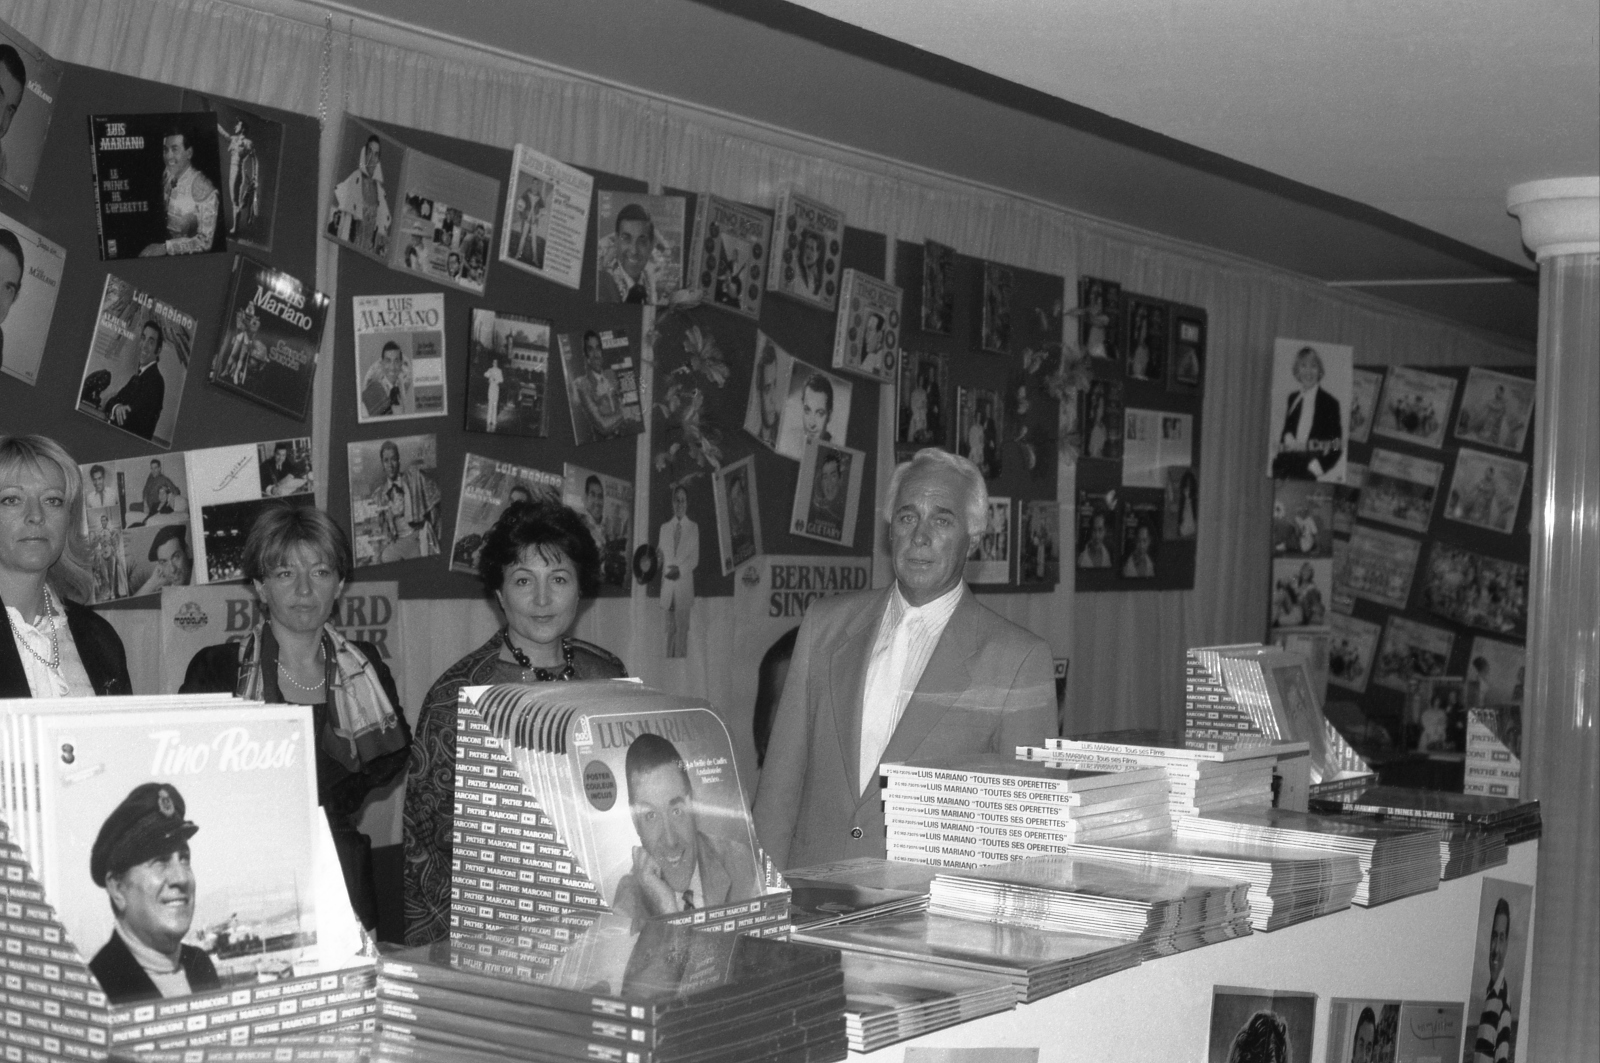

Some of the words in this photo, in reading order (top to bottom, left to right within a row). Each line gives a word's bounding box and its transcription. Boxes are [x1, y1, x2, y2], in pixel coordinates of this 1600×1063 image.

[105, 123, 126, 136] LUIS
[100, 136, 144, 150] MARIANO
[253, 284, 312, 330] Mariano
[386, 298, 412, 311] LUIS
[361, 308, 439, 328] MARIANO
[770, 565, 867, 590] BERNARD
[597, 721, 636, 749] LUIS
[149, 730, 209, 776] Tino
[212, 727, 300, 772] Rossi
[469, 751, 489, 759] PATHE
[587, 772, 610, 781] POSTER
[935, 772, 968, 782] MARIANO
[1002, 778, 1015, 786] SES
[468, 779, 488, 788] PATHE
[489, 783, 519, 792] MARCONI
[586, 782, 614, 790] COULEUR
[926, 783, 942, 791] LUIS
[944, 785, 978, 794] MARIANO
[1014, 791, 1027, 799] SES
[502, 798, 522, 807] PATHE
[590, 792, 612, 800] INCLUS
[920, 795, 935, 803] LUIS
[937, 796, 970, 806] MARIANO
[467, 808, 487, 816] PATHE
[489, 811, 518, 820] MARCONI
[924, 808, 940, 816] LUIS
[941, 809, 975, 819] MARIANO
[1010, 816, 1024, 824] SES
[501, 826, 521, 836] PATHE
[523, 830, 554, 840] MARCONI
[941, 822, 974, 832] MARIANO
[1009, 829, 1022, 837] SES
[466, 836, 486, 845] PATHE
[488, 839, 517, 849] MARCONI
[540, 847, 561, 856] PATHE
[943, 834, 976, 844] MARIANO
[1011, 841, 1025, 850] SES
[925, 845, 940, 853] LUIS
[942, 847, 975, 857] MARIANO
[500, 855, 520, 864] PATHE
[523, 858, 552, 869] MARCONI
[926, 858, 941, 866] LUIS
[943, 859, 977, 869] MARIANO
[465, 864, 485, 872] PATHE
[487, 867, 516, 878] MARCONI
[540, 875, 560, 884] PATHE
[562, 879, 595, 890] MARCONI
[499, 884, 520, 893] PATHE
[522, 887, 552, 898] MARCONI
[576, 896, 598, 905] PATHE
[464, 892, 484, 901] PATHE
[486, 896, 516, 906] MARCONI
[538, 904, 560, 914] PATHE
[499, 912, 519, 921] PATHE
[464, 919, 484, 929] PATHE
